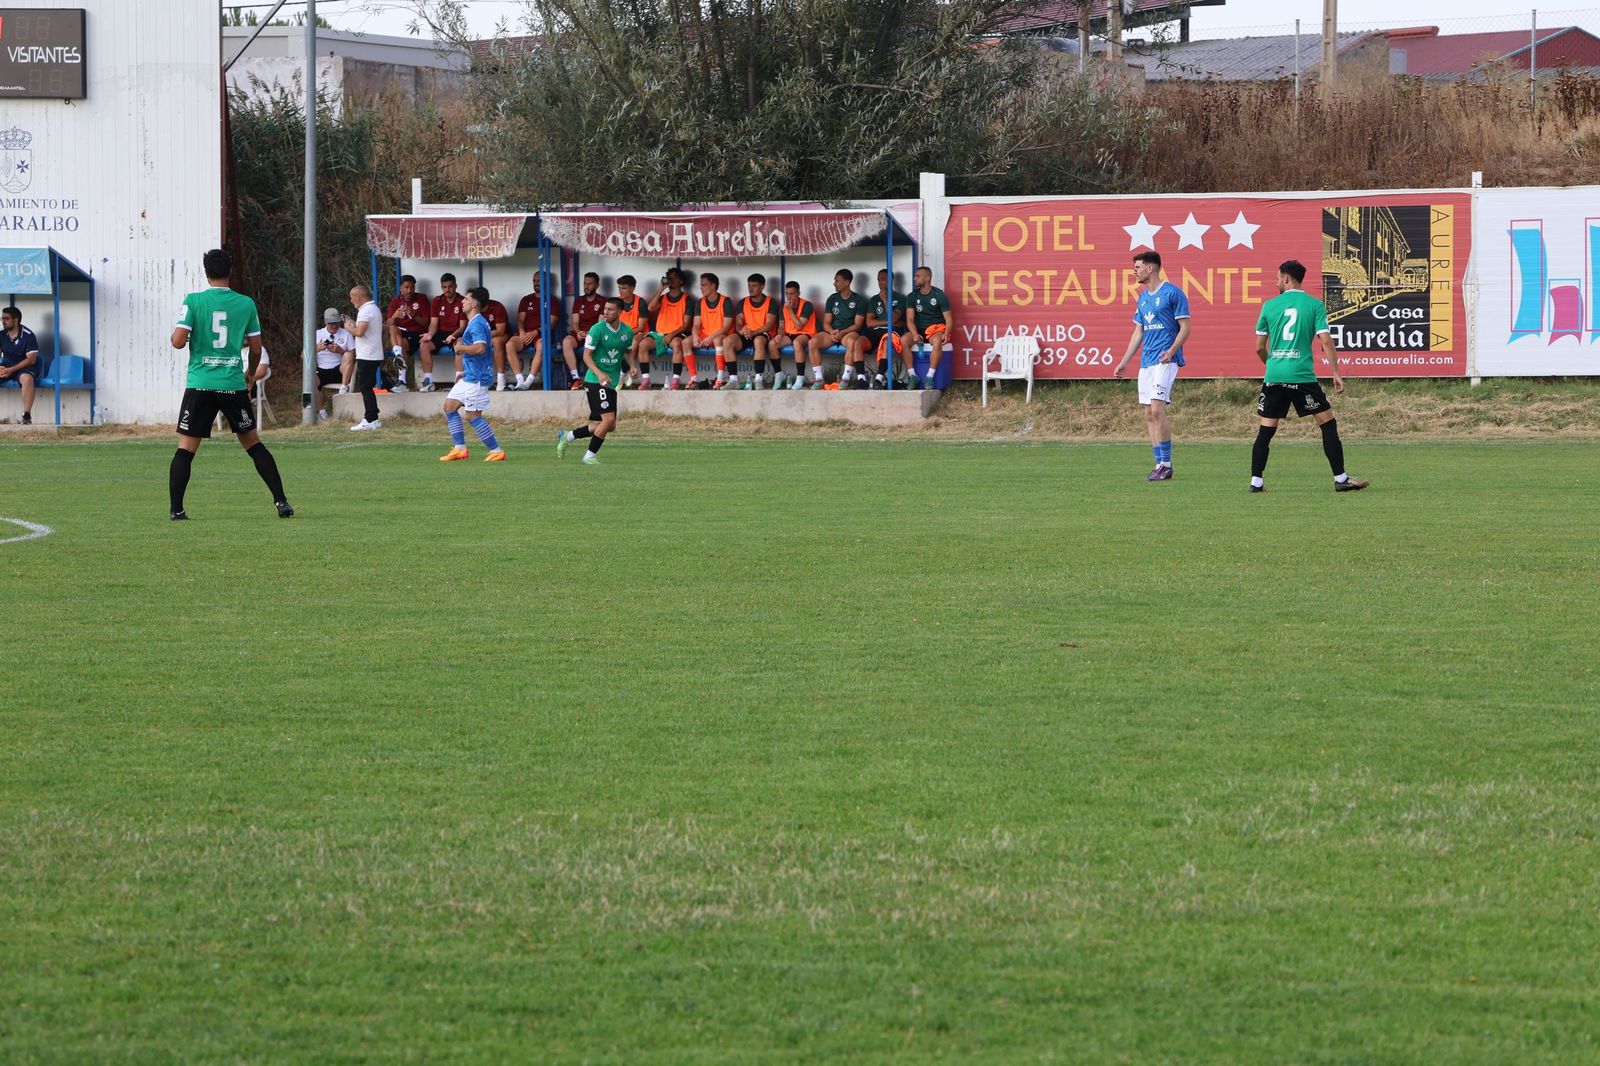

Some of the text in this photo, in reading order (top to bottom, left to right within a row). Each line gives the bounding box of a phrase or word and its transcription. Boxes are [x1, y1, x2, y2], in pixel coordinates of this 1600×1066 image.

[7, 46, 81, 63] VISITANTES
[62, 199, 79, 210] DE
[466, 224, 513, 240] HOTEL
[580, 222, 662, 254] Casa
[962, 215, 1095, 252] HOTEL
[1431, 208, 1450, 347] AURELIA
[1372, 304, 1424, 320] Casa
[211, 311, 228, 349] 5
[962, 324, 1086, 342] VILLARALBO
[1282, 307, 1298, 341] 2
[962, 348, 977, 366] T.
[1075, 347, 1113, 366] 626
[599, 388, 607, 400] 8
